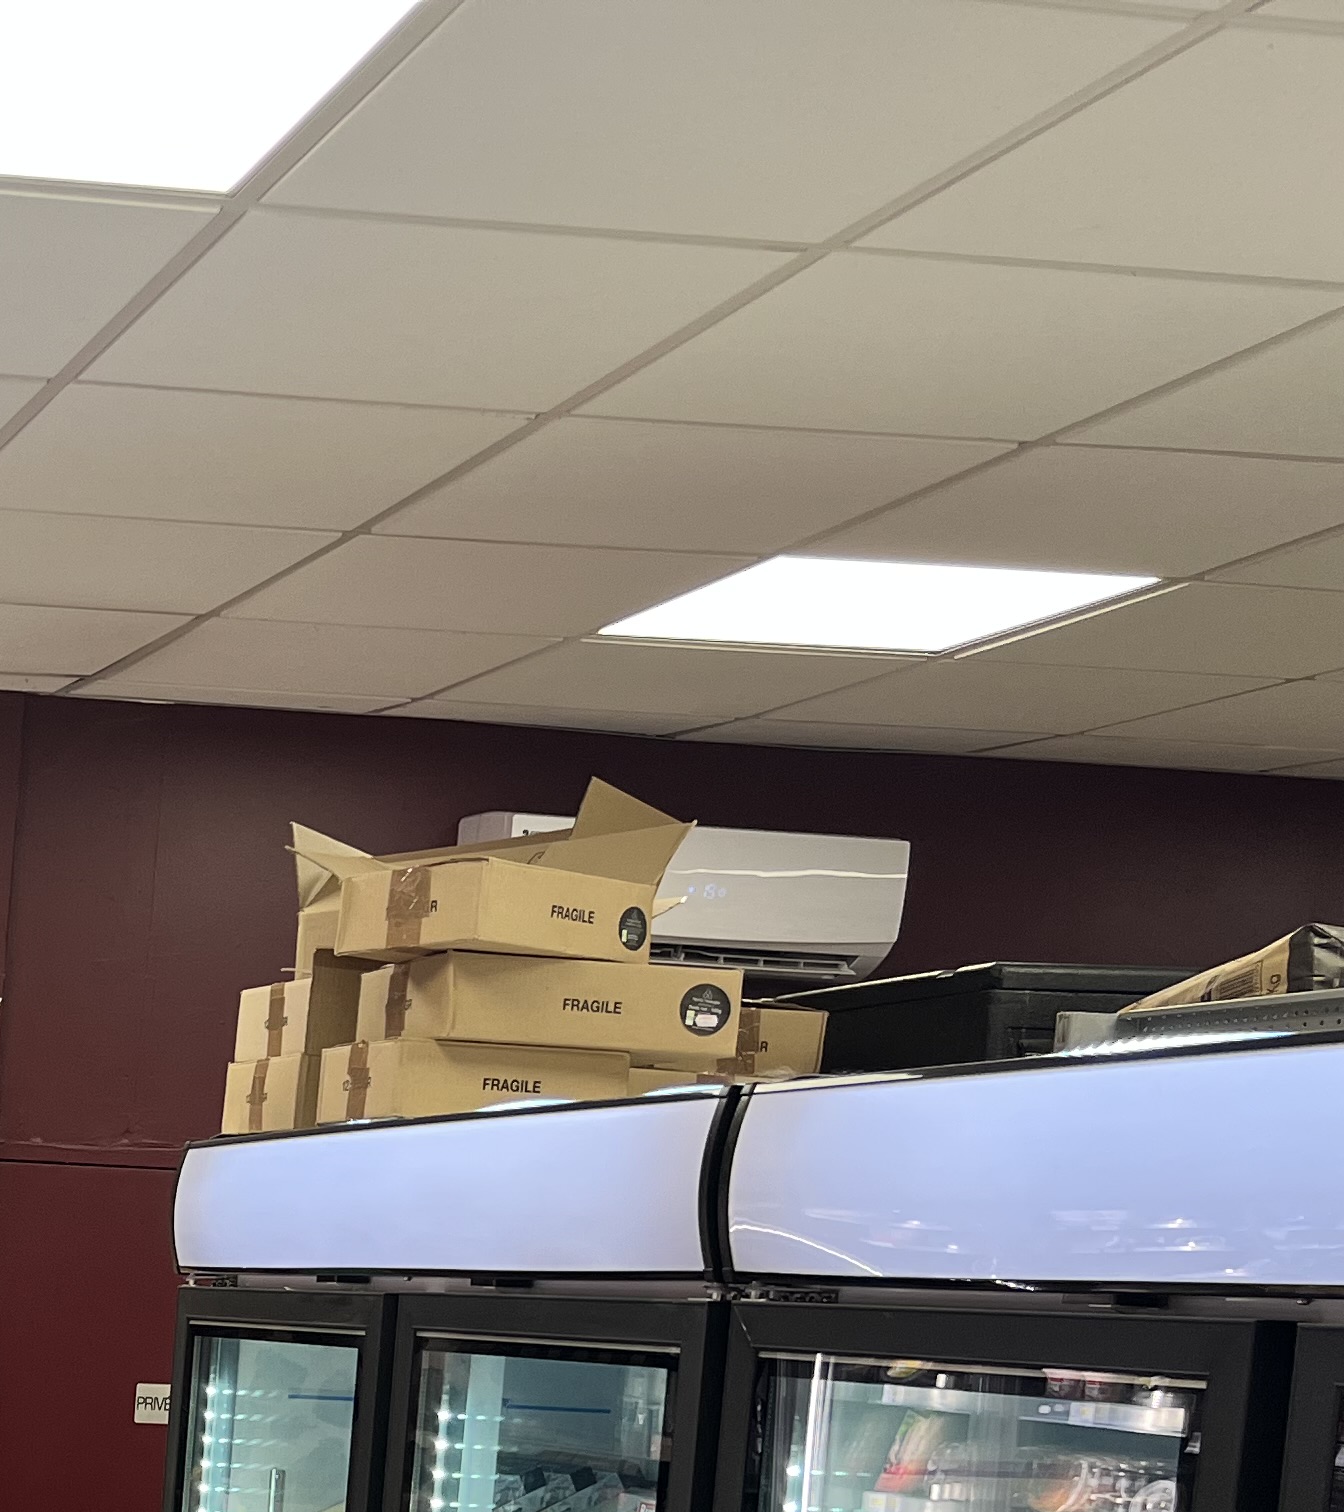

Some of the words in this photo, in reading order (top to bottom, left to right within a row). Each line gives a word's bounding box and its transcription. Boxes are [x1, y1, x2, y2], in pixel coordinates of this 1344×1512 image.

[550, 904, 596, 925] FRAGILE
[562, 998, 623, 1015] FRAGILE
[482, 1077, 543, 1094] FRAGILE
